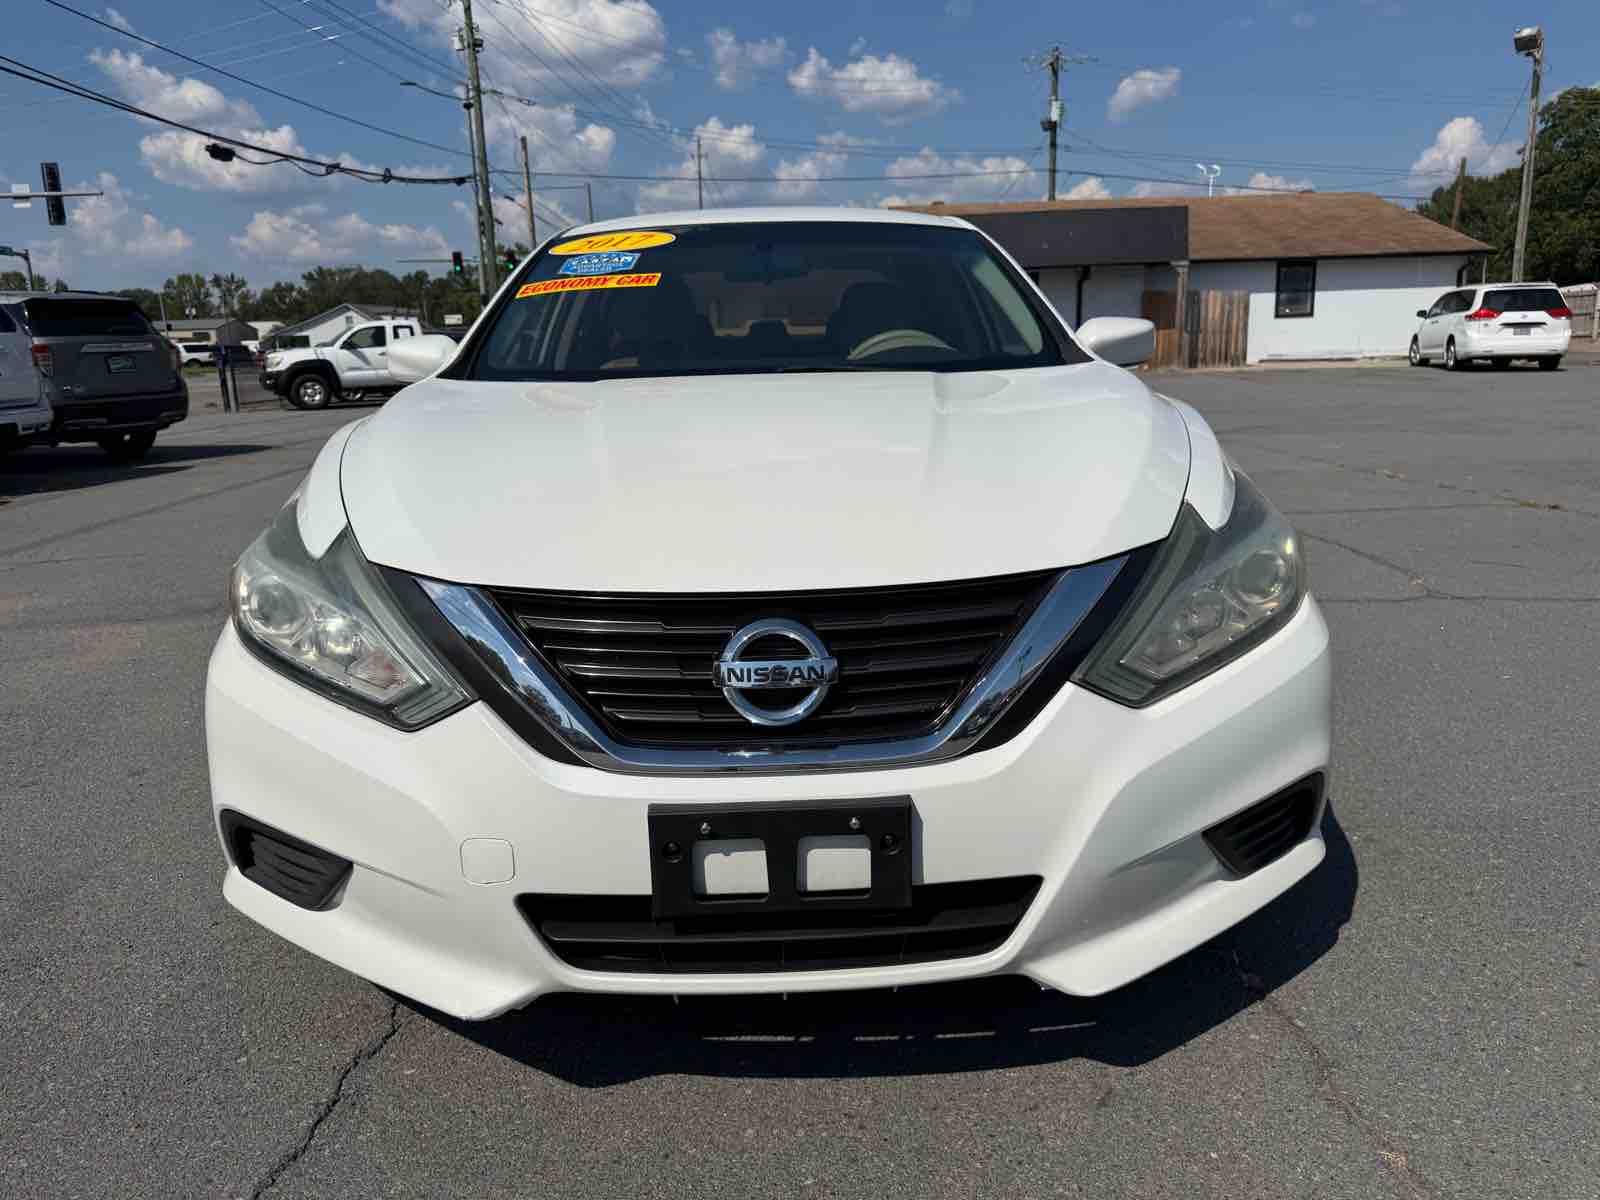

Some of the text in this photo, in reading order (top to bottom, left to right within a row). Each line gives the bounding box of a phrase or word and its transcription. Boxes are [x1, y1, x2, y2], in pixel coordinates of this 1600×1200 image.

[574, 233, 655, 252] 2017
[519, 275, 657, 295] ECONOMY CAR
[726, 664, 825, 683] NISSAN
